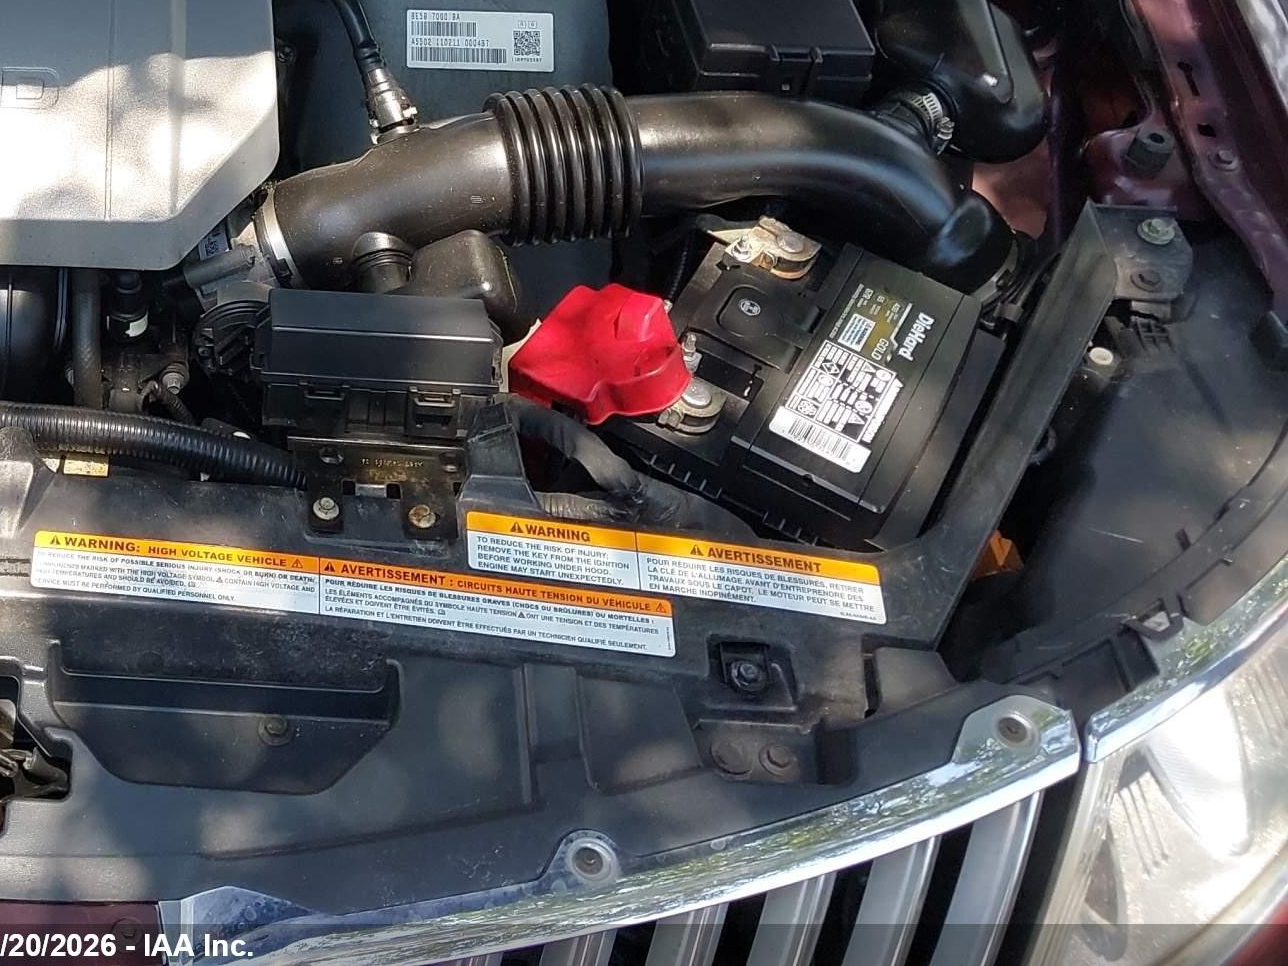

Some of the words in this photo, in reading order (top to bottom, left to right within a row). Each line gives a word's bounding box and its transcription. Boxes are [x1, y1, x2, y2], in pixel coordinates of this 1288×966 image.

[871, 337, 889, 361] GOLD
[897, 311, 935, 362] DieHard
[525, 523, 590, 541] WARNING
[64, 536, 140, 552] WARNING:
[148, 544, 176, 556] HIGH
[181, 547, 232, 561] VOLTAGE
[237, 552, 286, 566] VEHICLE
[477, 536, 487, 544] TO
[491, 538, 522, 548] REDUCE
[526, 542, 540, 551] THE
[543, 544, 561, 553] RISK
[564, 547, 574, 555] OF
[477, 544, 511, 554] REMOVE
[514, 549, 529, 557] THE
[532, 551, 547, 559] KEY
[550, 553, 573, 562] FROM
[576, 556, 591, 565] THE
[593, 559, 629, 569] IGNITION
[120, 558, 153, 567] POSSIBLE
[156, 561, 185, 570] SERIOUS
[187, 564, 212, 572] INJURY
[478, 552, 510, 563] BEFORE
[513, 557, 552, 568] WORKING
[554, 562, 582, 572] UNDER
[585, 566, 611, 575] HOOD.
[706, 546, 822, 572] AVERTISSEMENT
[118, 574, 144, 583] SHOULD
[157, 571, 186, 579] VOLTAGE
[187, 574, 214, 582] SYMBOL
[224, 577, 251, 586] CONTAIN
[270, 582, 302, 590] VOLTAGE
[340, 563, 444, 585] AVERTISSEMENT
[457, 577, 501, 592] CIRCUITS
[505, 583, 536, 597] HAUTE
[541, 587, 582, 602] TENSION
[586, 593, 599, 604] DU
[478, 560, 508, 571] ENGINE
[510, 564, 527, 573] MAY
[530, 567, 555, 577] START
[557, 570, 623, 586] UNEXPECTEDLY.
[646, 555, 669, 566] POUR
[708, 564, 724, 574] LES
[726, 566, 762, 579] RISQUES
[764, 572, 775, 581] DE
[777, 574, 827, 589] BLESSURES,
[829, 581, 864, 594] RETIRER
[647, 564, 658, 573] LA
[677, 568, 688, 577] DE
[691, 570, 742, 585] L'ALLUMAGE
[744, 578, 771, 589] AVANT
[772, 582, 845, 599] D'ENTREPRENDRE
[847, 592, 863, 602] DES
[142, 586, 176, 595] QUALIFIED
[178, 590, 215, 599] PERSONNEL
[217, 593, 235, 601] ONLY.
[325, 578, 344, 586] POUR
[379, 584, 392, 592] LES
[395, 586, 425, 596] RISQUES
[439, 591, 479, 602] BLESSURES
[482, 597, 510, 606] GRAVES
[512, 600, 538, 609] (CHOCS
[607, 612, 649, 623] MORTELLES
[364, 600, 391, 609] DOIVENT
[648, 573, 685, 585] TRAVAUX
[687, 579, 710, 588] SOUS
[712, 582, 722, 590] LE
[770, 590, 804, 601] MOTEUR
[806, 595, 827, 605] PEUT
[842, 600, 875, 611] METTRE
[648, 581, 659, 590] EN
[661, 583, 697, 595] MARCHE
[699, 588, 756, 603] INOPINÉMENT.
[325, 587, 336, 595] LES
[424, 599, 432, 607] DU
[434, 600, 464, 610] SYMBOLE
[466, 604, 487, 613] HAUTE
[489, 607, 516, 617] TENSION
[526, 611, 539, 619] ONT
[540, 613, 553, 621] UNE
[555, 615, 582, 625] TENSION
[584, 618, 592, 626] ET
[593, 619, 606, 628] DES
[325, 604, 333, 612] LA
[334, 605, 374, 617] RÉPARATION
[376, 610, 384, 618] ET
[386, 611, 426, 623] L'ENTRETIEN
[428, 616, 455, 626] DOIVENT
[513, 627, 525, 635] PAR
[527, 628, 536, 636] UN
[538, 630, 575, 641] TECHNICIEN
